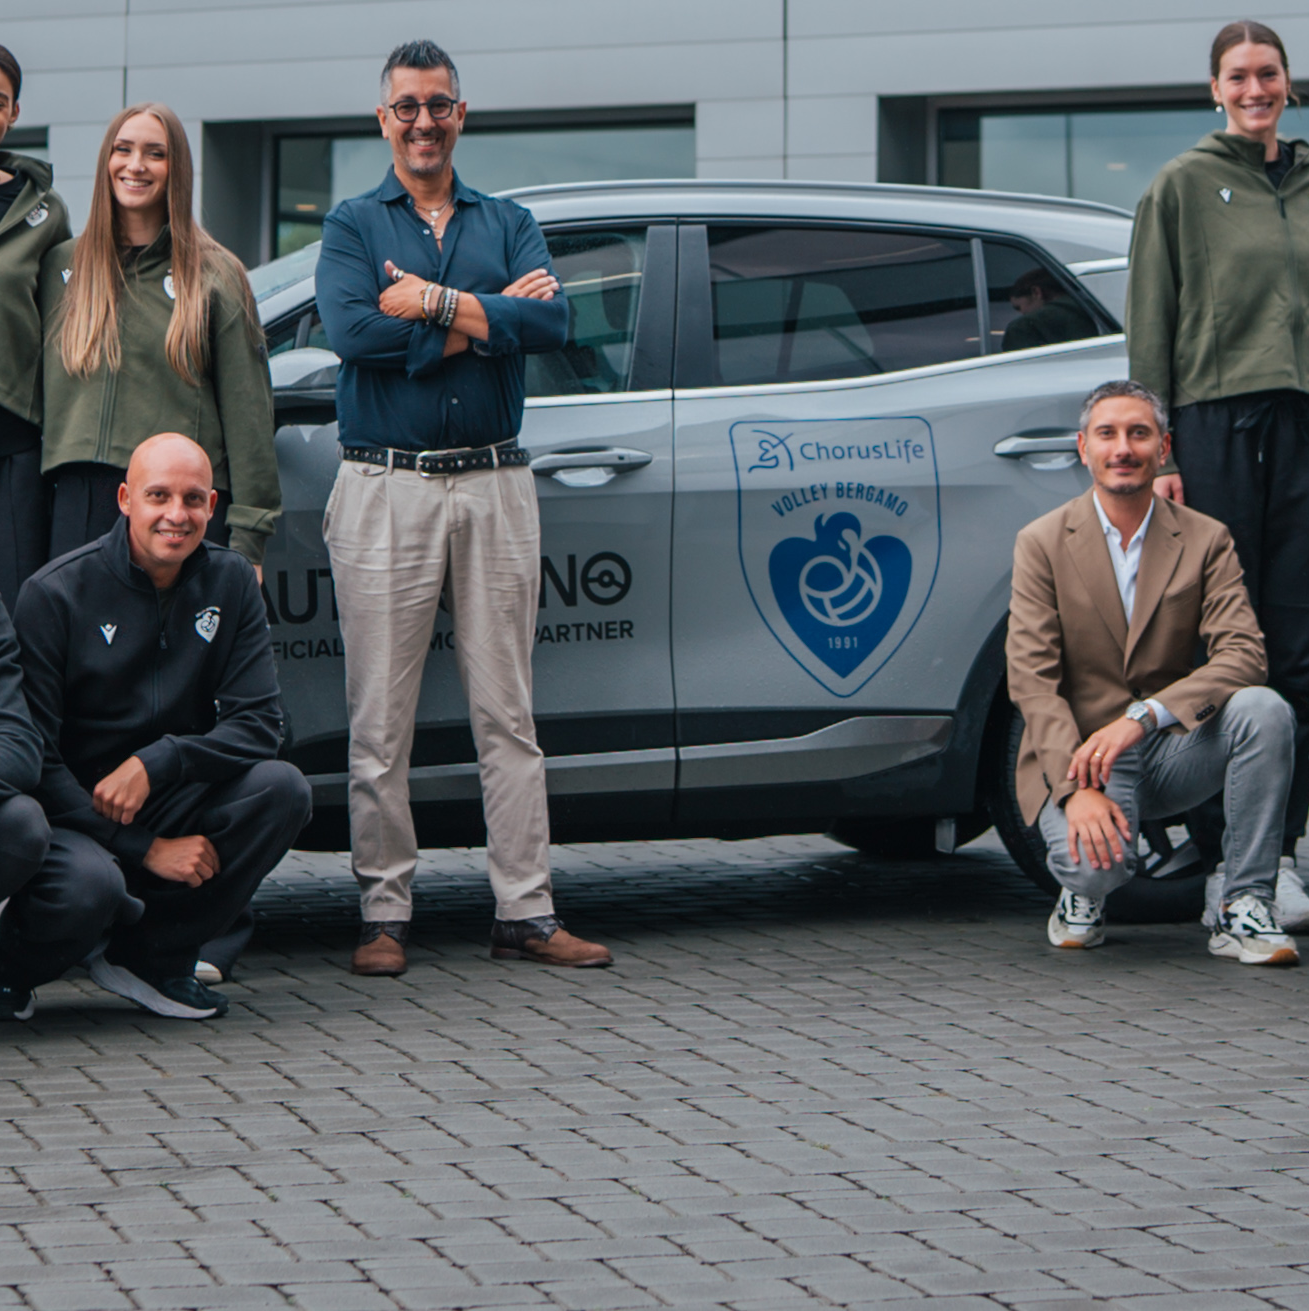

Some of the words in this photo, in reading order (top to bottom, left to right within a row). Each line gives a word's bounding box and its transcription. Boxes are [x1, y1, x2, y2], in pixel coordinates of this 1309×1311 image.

[799, 439, 925, 463] ChorusLife
[771, 482, 828, 518] VOLLEY
[835, 481, 909, 518] BERGAMO
[534, 619, 634, 644] ARTNER
[828, 636, 858, 649] 1991
